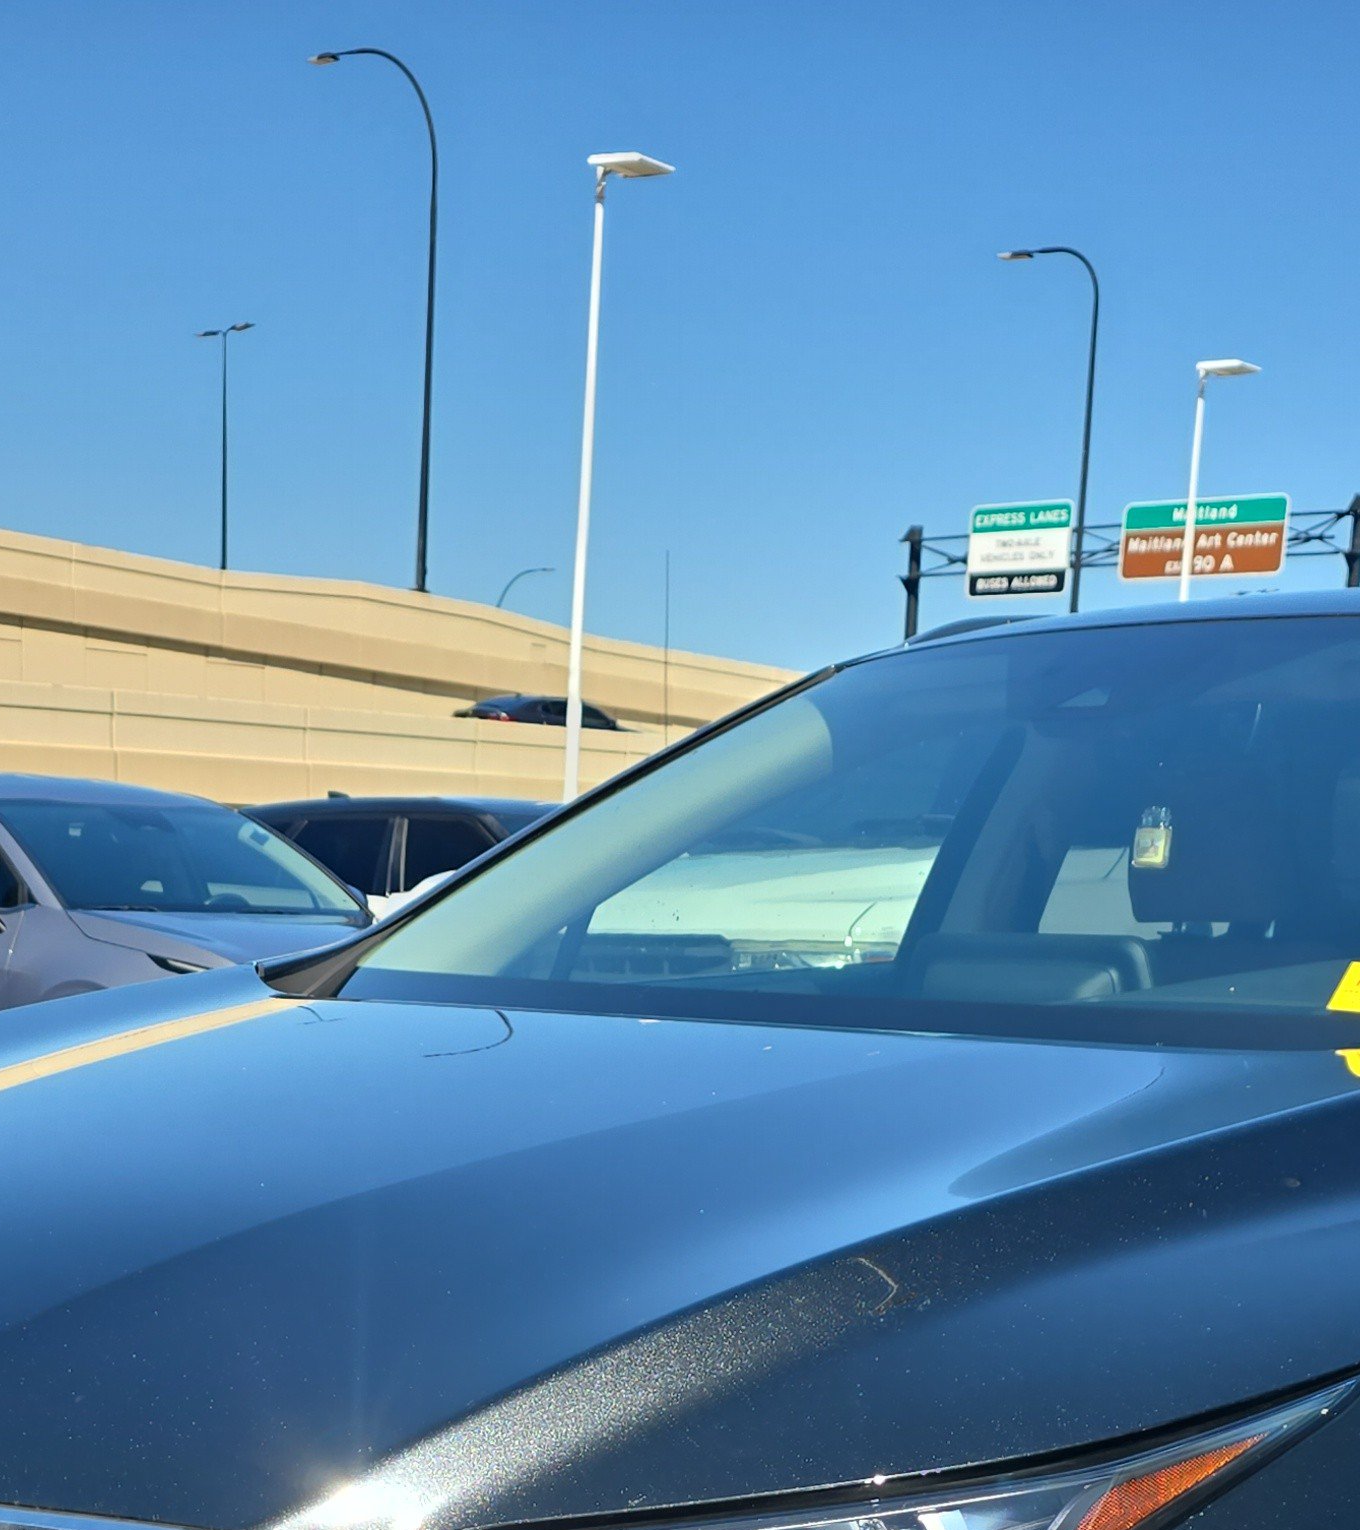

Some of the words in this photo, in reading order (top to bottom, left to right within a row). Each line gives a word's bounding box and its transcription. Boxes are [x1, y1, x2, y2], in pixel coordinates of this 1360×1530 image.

[974, 511, 1026, 529] EXPRESS
[1029, 508, 1069, 526] LANES
[1172, 504, 1238, 522] Mtland
[1127, 536, 1189, 554] Maitlan
[1196, 532, 1222, 550] Art
[1226, 530, 1280, 549] Center
[1192, 555, 1216, 573] 90
[1219, 554, 1235, 571] A
